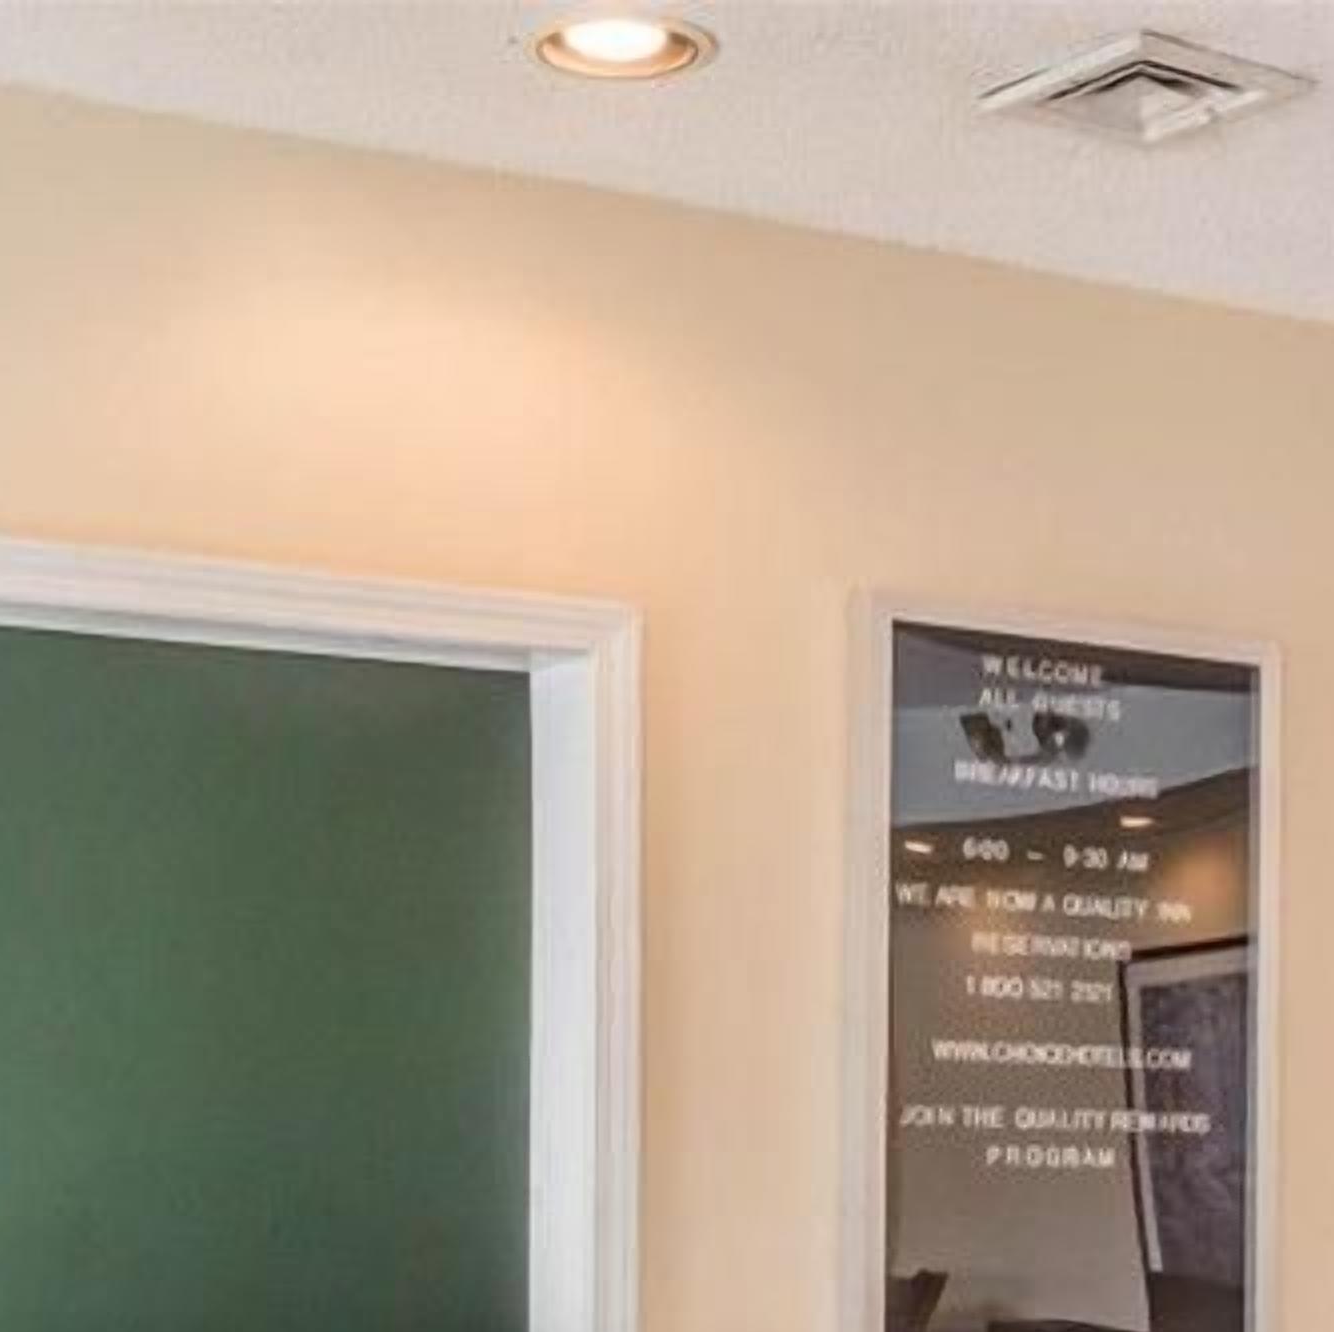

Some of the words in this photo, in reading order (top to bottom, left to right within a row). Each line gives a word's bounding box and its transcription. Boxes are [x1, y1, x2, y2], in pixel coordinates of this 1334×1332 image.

[981, 654, 1103, 688] WELCOME
[986, 888, 1037, 912] NOW
[1063, 893, 1149, 920] QUALITY
[900, 1105, 955, 1127] JOIN
[962, 1106, 1006, 1129] THE
[985, 1144, 1116, 1168] PROGRAM
